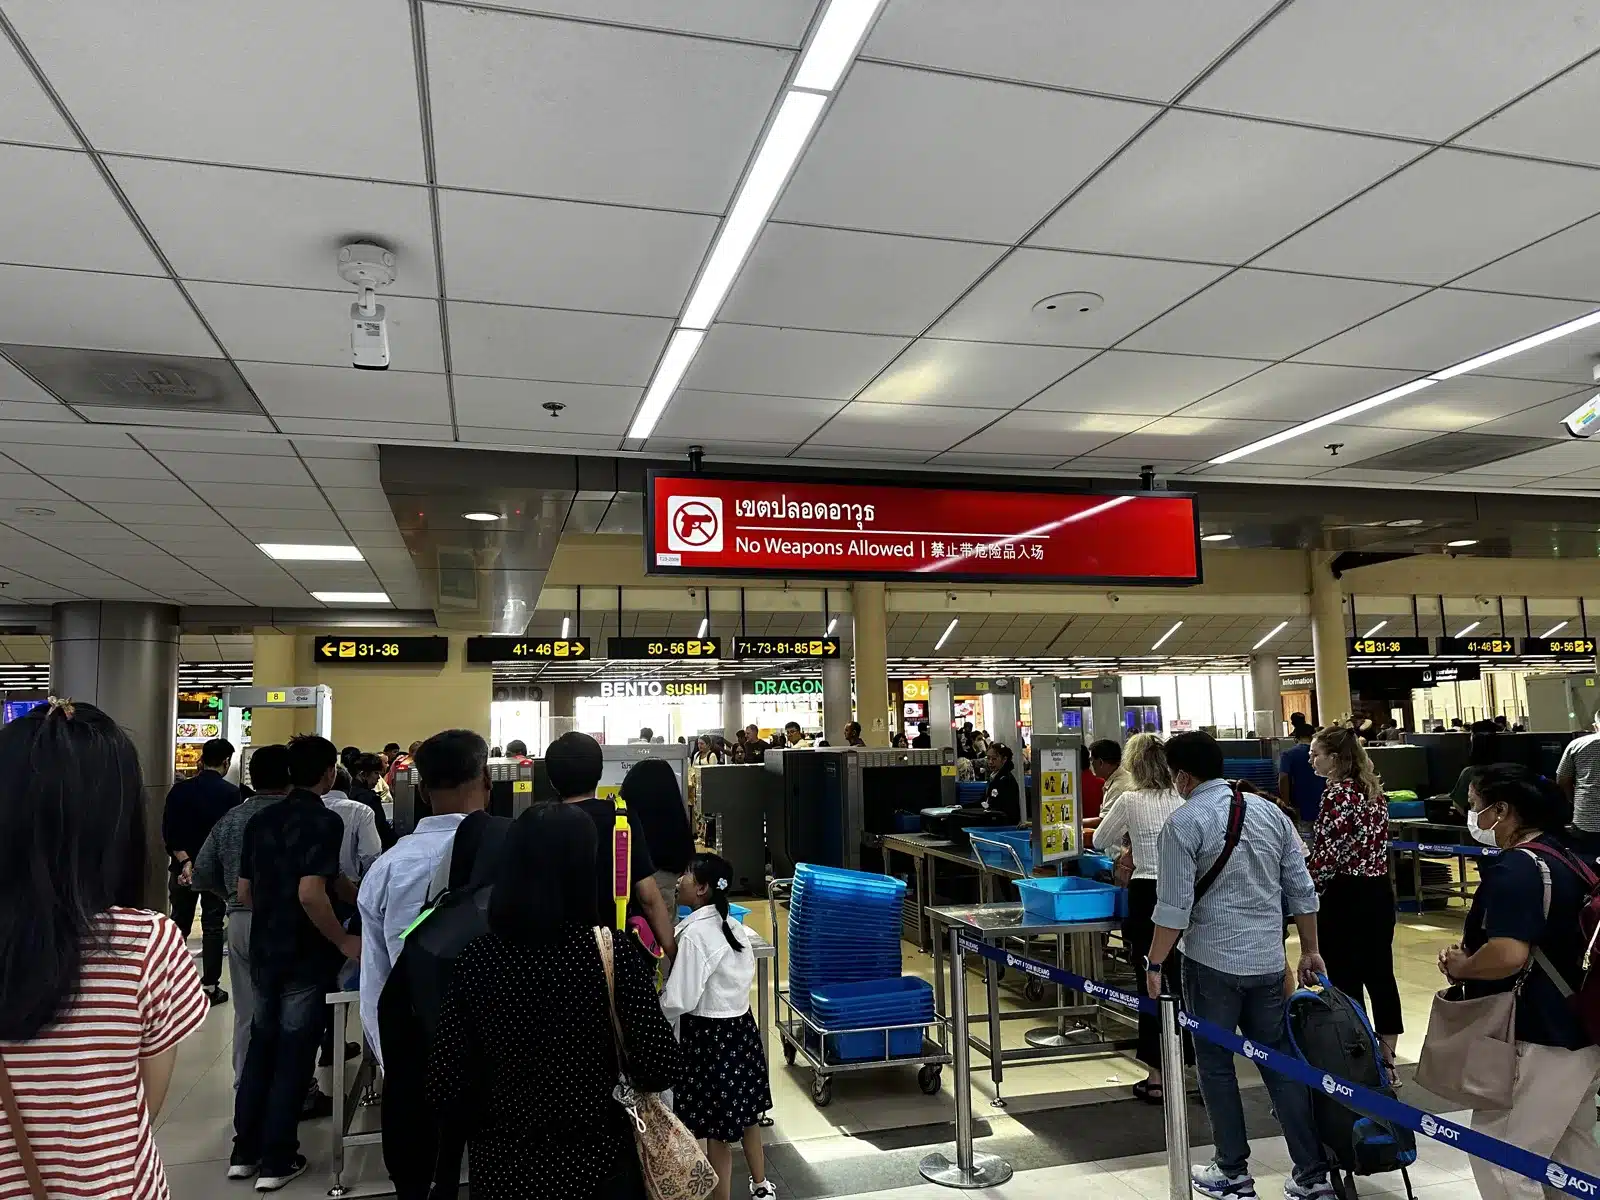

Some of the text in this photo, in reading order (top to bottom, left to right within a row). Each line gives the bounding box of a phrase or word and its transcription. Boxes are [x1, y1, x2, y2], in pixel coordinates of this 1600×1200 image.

[735, 494, 875, 530] เขตปลอดอาวุธ
[735, 536, 914, 558] No Weapons Allowed
[930, 542, 1044, 561] 禁止带危险品入场
[358, 643, 400, 656] 31-36
[513, 643, 552, 656] 41-46
[648, 642, 685, 655] 50-56
[754, 680, 824, 695] DRAGON
[1282, 676, 1314, 686] Information
[600, 681, 707, 697] BENTO SUSHI
[1186, 1018, 1200, 1029] AOT
[1253, 1048, 1269, 1061] AOT
[1335, 1083, 1354, 1098] AOT
[1437, 1125, 1461, 1141] AOT
[1567, 1176, 1598, 1196] AOT
